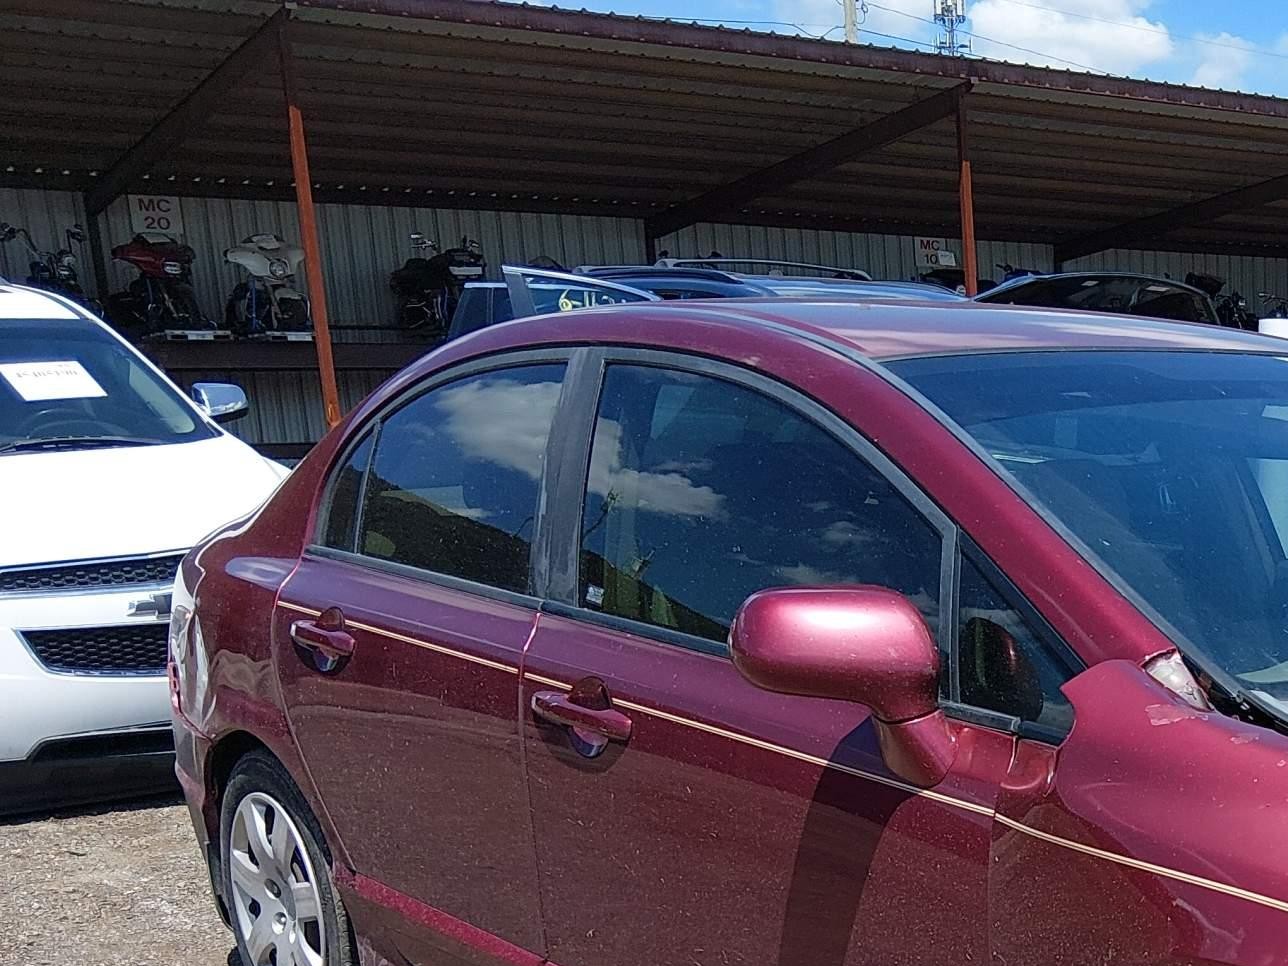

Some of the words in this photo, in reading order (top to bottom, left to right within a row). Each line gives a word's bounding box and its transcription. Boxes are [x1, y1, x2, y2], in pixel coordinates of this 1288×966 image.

[138, 198, 171, 212] MC
[144, 216, 170, 230] 20
[920, 239, 940, 251] MC
[926, 254, 938, 264] 10
